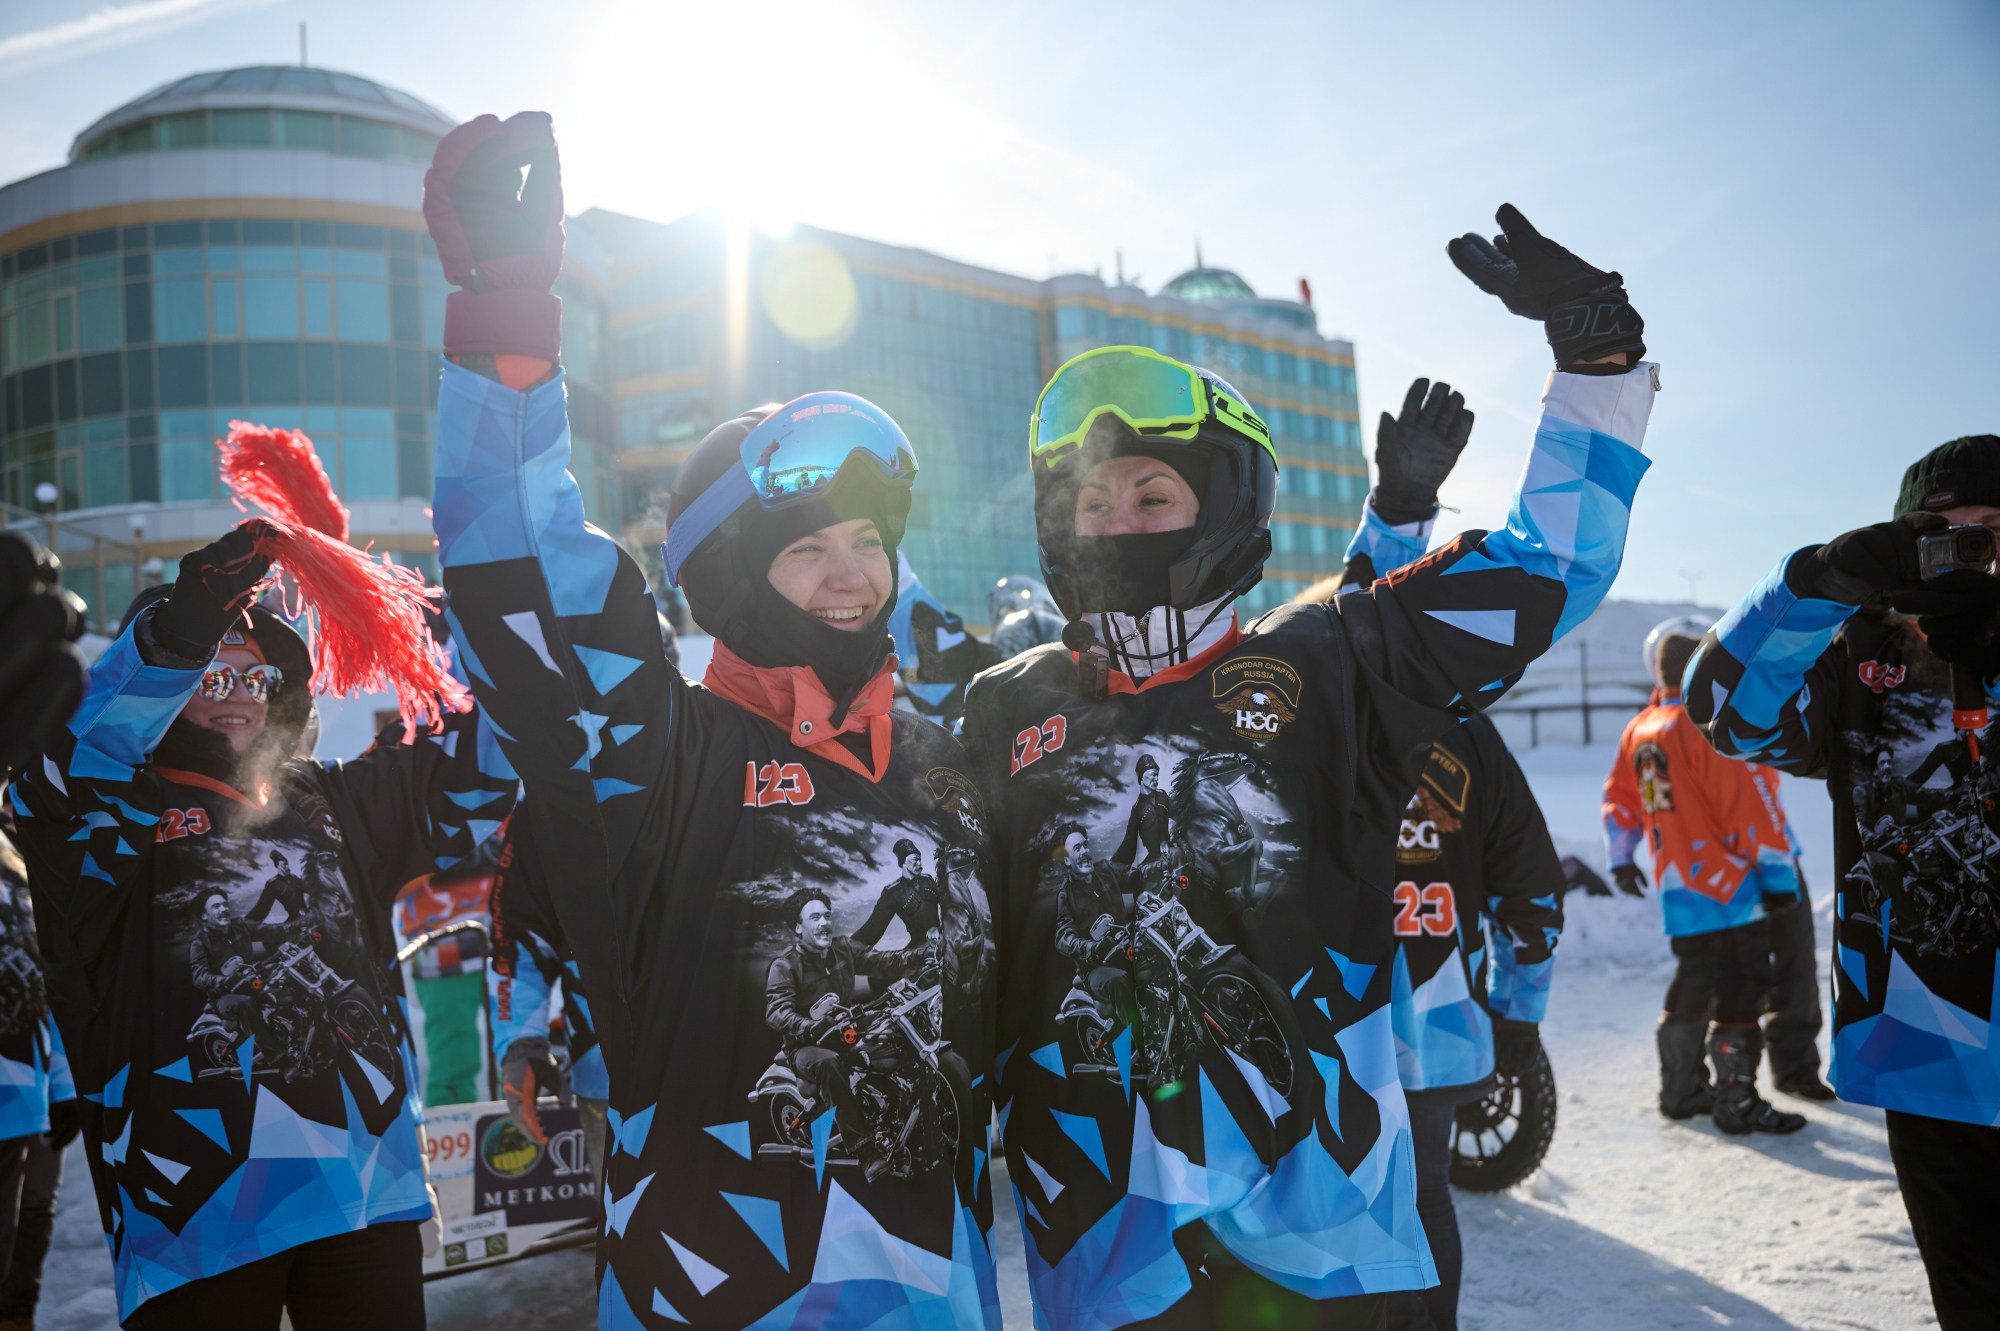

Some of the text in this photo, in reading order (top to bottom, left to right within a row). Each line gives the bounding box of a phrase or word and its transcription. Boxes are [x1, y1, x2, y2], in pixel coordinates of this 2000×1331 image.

[1220, 661, 1296, 683] KRASNODAR CHAPTER
[1243, 670, 1275, 680] RUSSIA
[1236, 709, 1279, 733] HOG
[154, 807, 212, 843] 23
[1397, 819, 1440, 850] OG
[484, 1181, 596, 1208] METKOM
